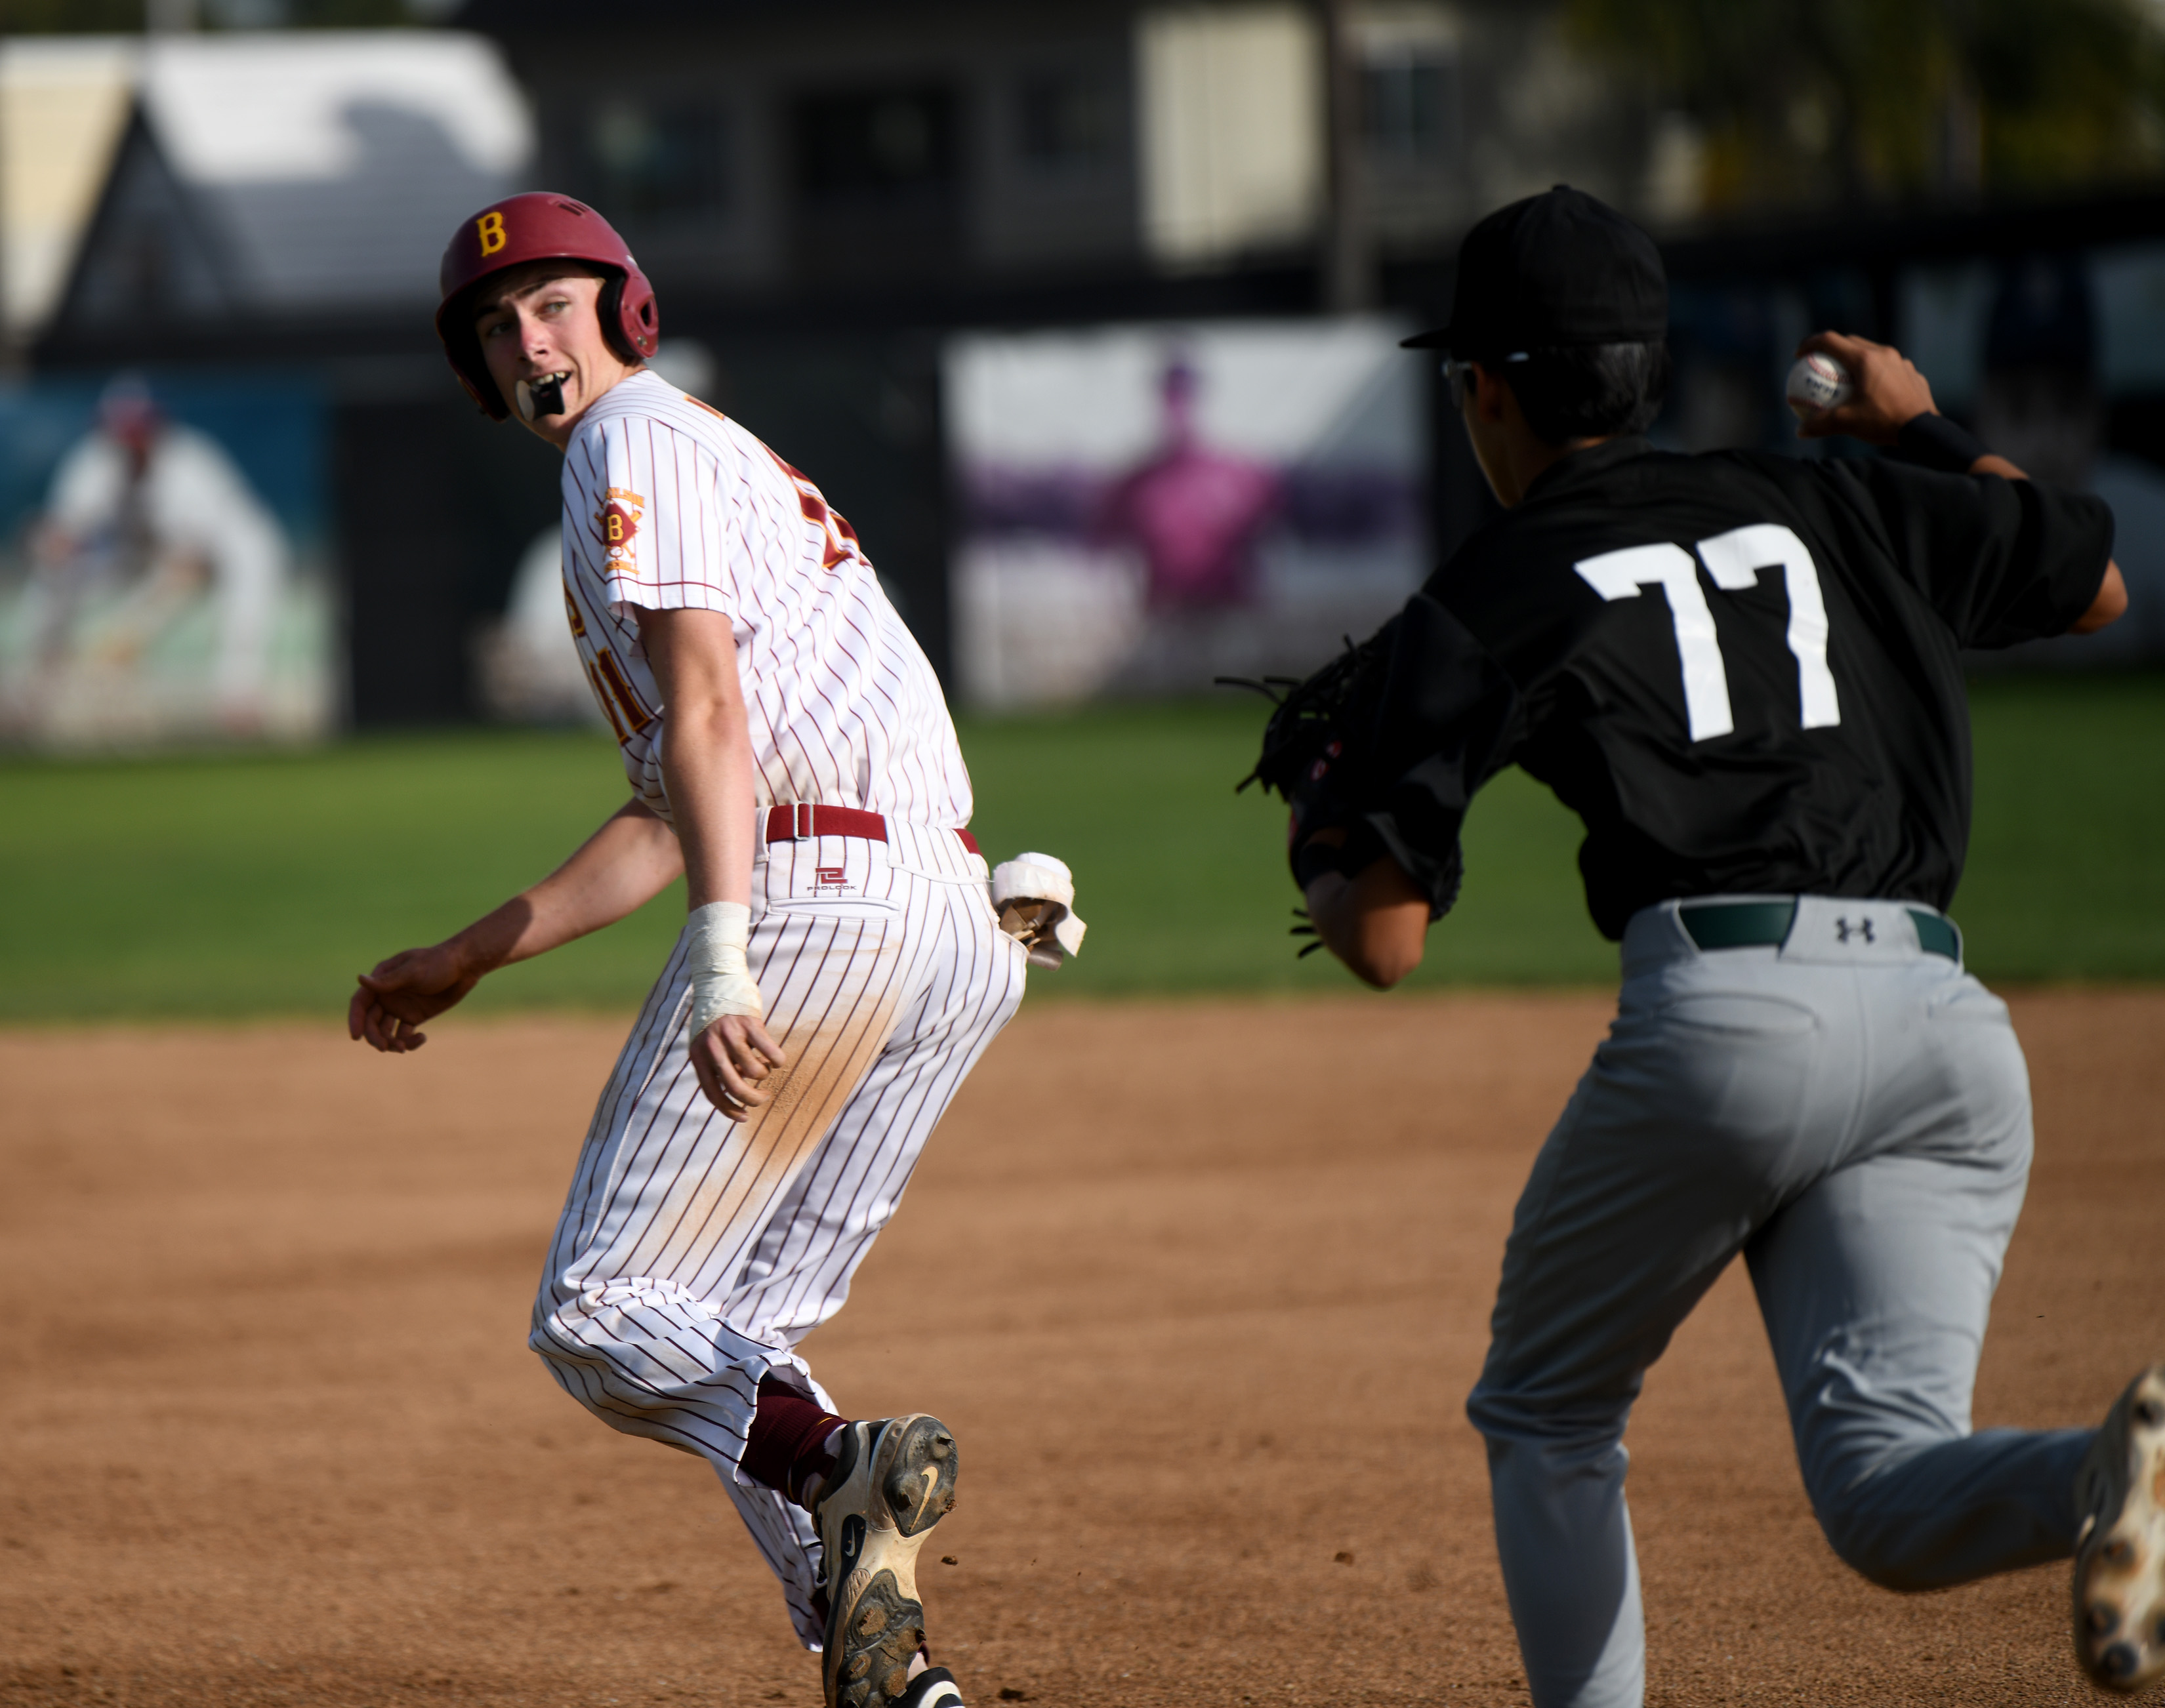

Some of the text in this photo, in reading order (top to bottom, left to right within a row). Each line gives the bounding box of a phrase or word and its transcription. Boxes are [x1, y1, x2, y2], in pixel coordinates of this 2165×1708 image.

[476, 211, 506, 257] B
[608, 514, 624, 541] B
[1573, 523, 1841, 742] 77
